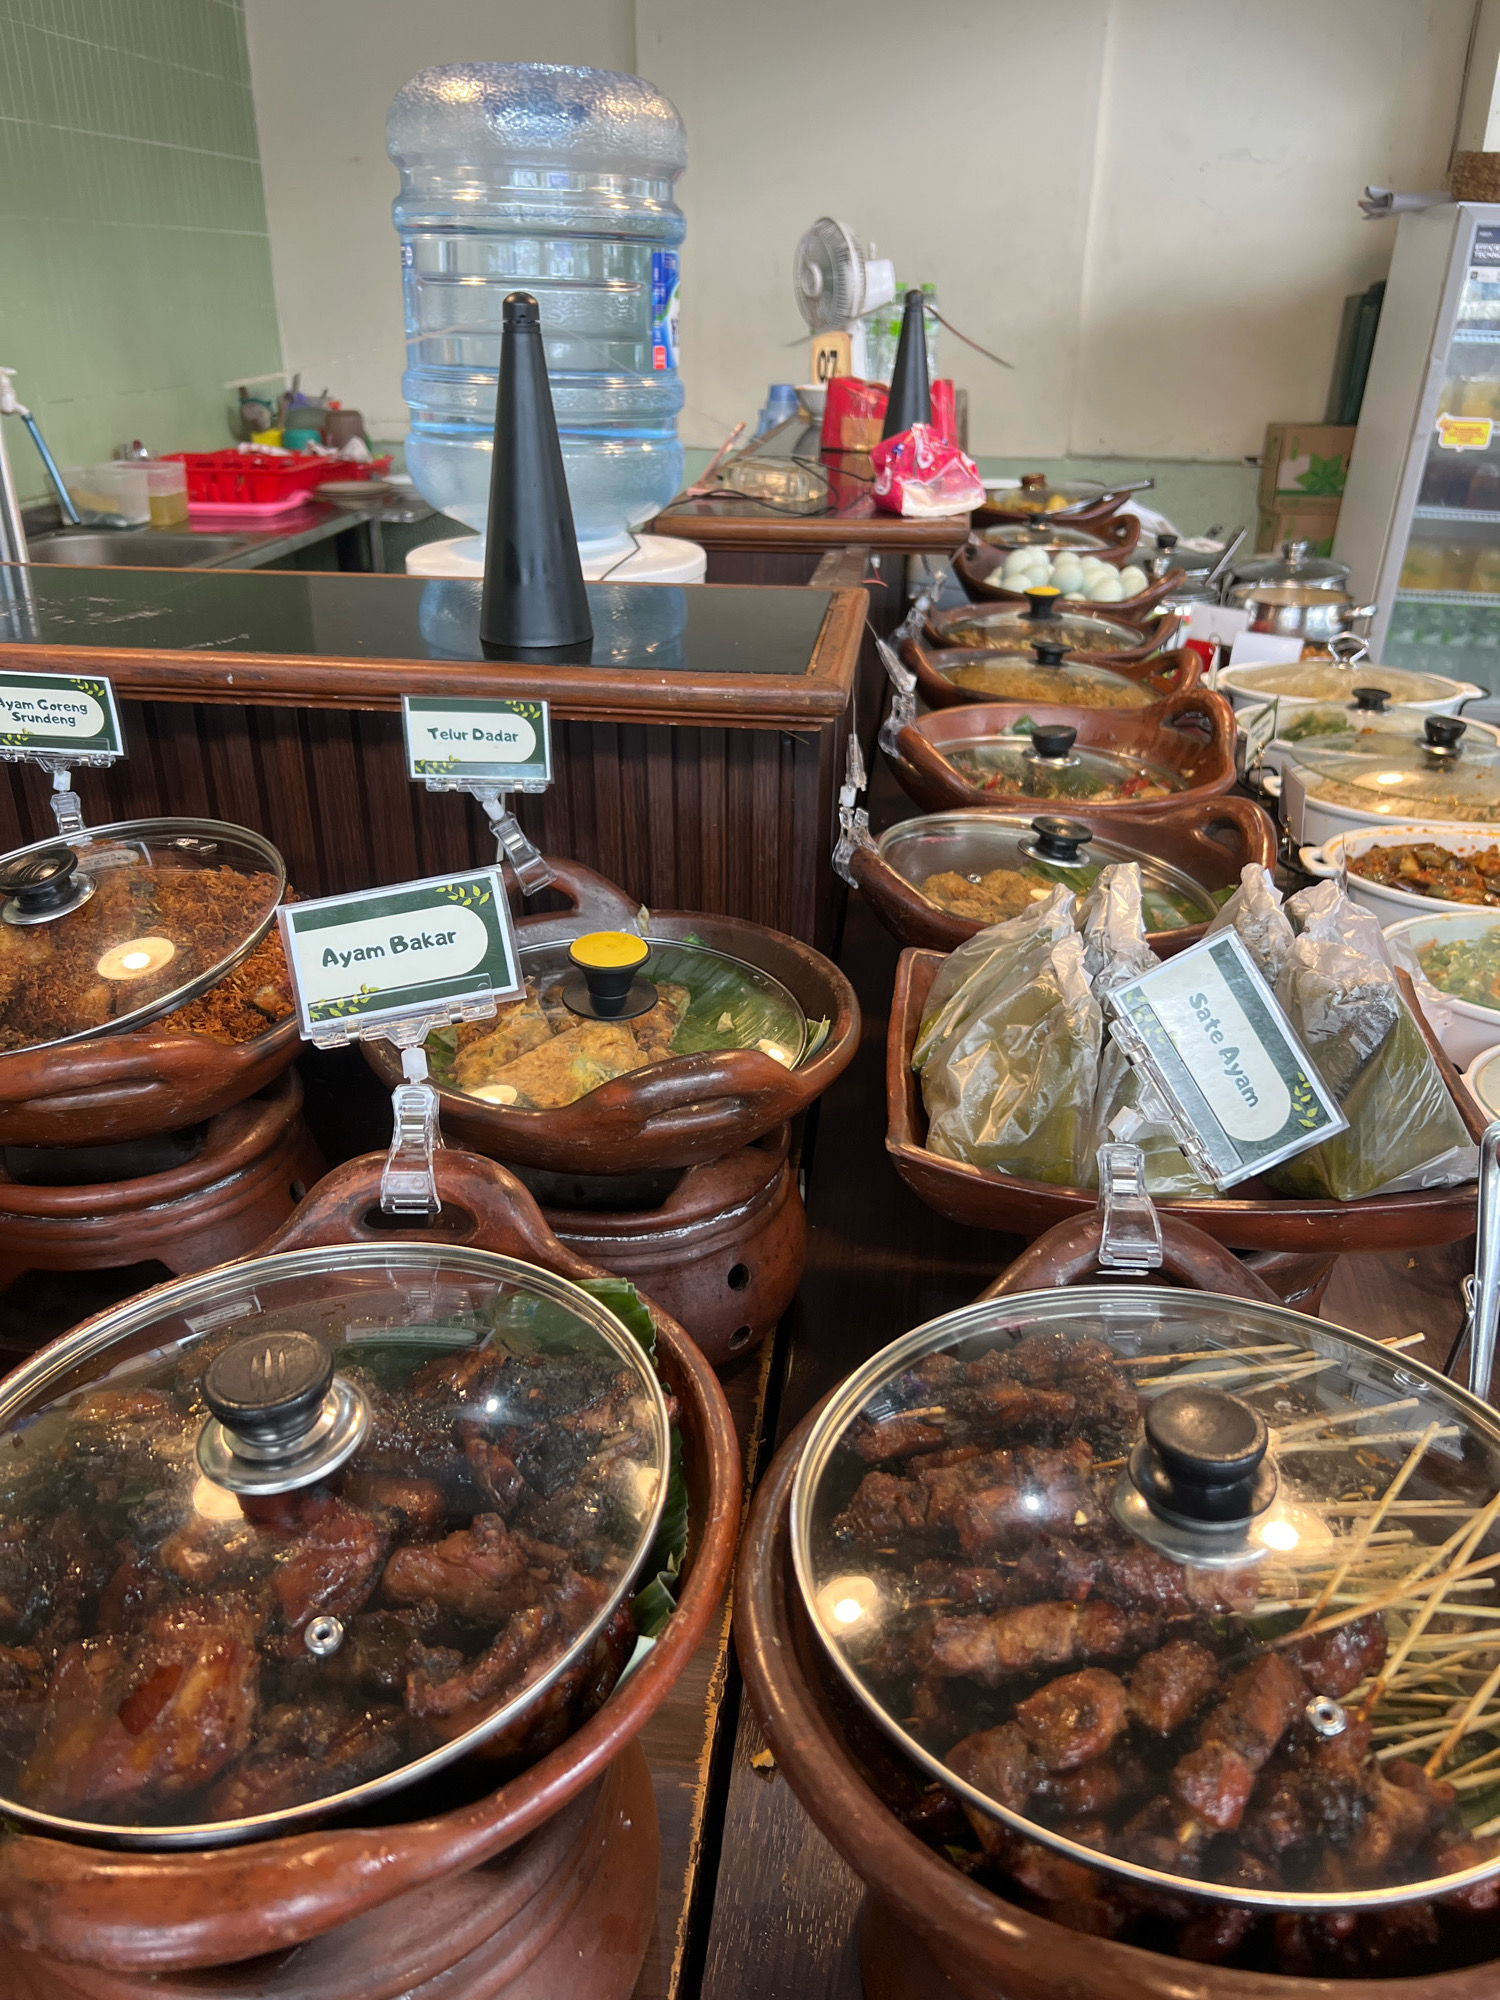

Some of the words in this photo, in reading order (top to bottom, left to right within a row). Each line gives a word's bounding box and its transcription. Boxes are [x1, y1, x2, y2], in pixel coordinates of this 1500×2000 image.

[37, 699, 88, 715] Goreng
[12, 712, 76, 727] Srundeng
[427, 727, 468, 741] Telur
[472, 728, 519, 742] Dadar
[322, 947, 385, 968] Ayam
[389, 930, 457, 955] Bakar
[1189, 992, 1224, 1045] Sate
[1218, 1046, 1259, 1108] Ayam
